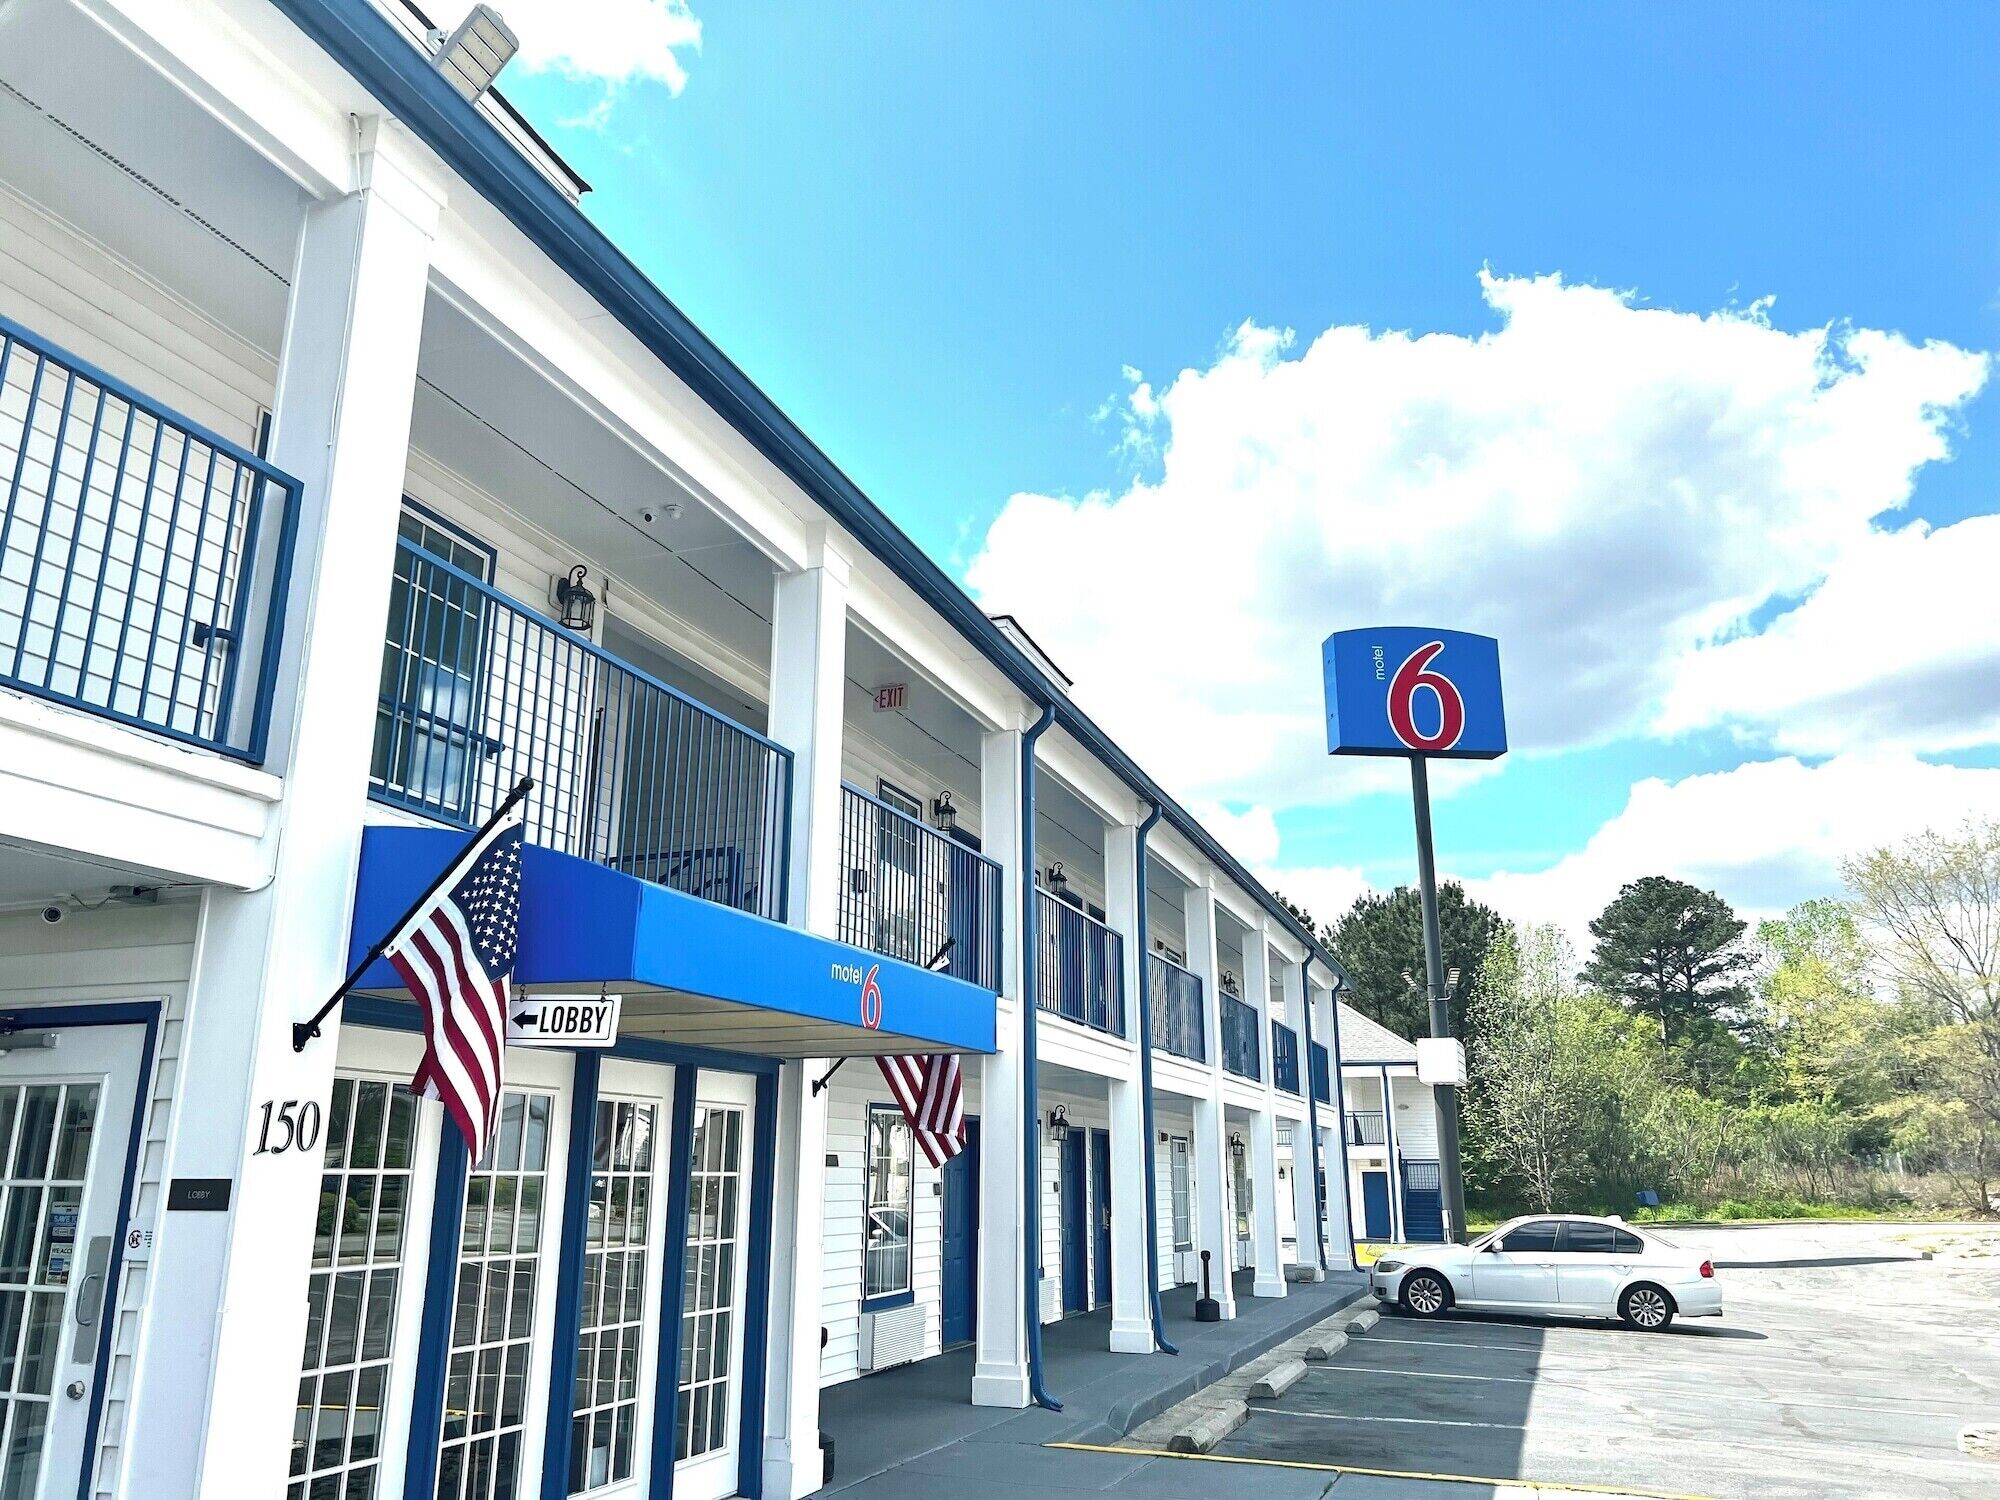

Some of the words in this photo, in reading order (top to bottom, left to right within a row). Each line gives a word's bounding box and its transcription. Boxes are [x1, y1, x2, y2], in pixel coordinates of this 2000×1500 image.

[880, 687, 904, 708] EXIT
[1371, 645, 1386, 680] motel
[1386, 640, 1465, 750] 6
[831, 963, 863, 985] motel
[861, 963, 882, 1030] 6
[539, 1006, 608, 1033] LOBBY
[252, 1100, 321, 1156] 150
[187, 1190, 211, 1200] LOBBY
[53, 1215, 70, 1223] SAVE
